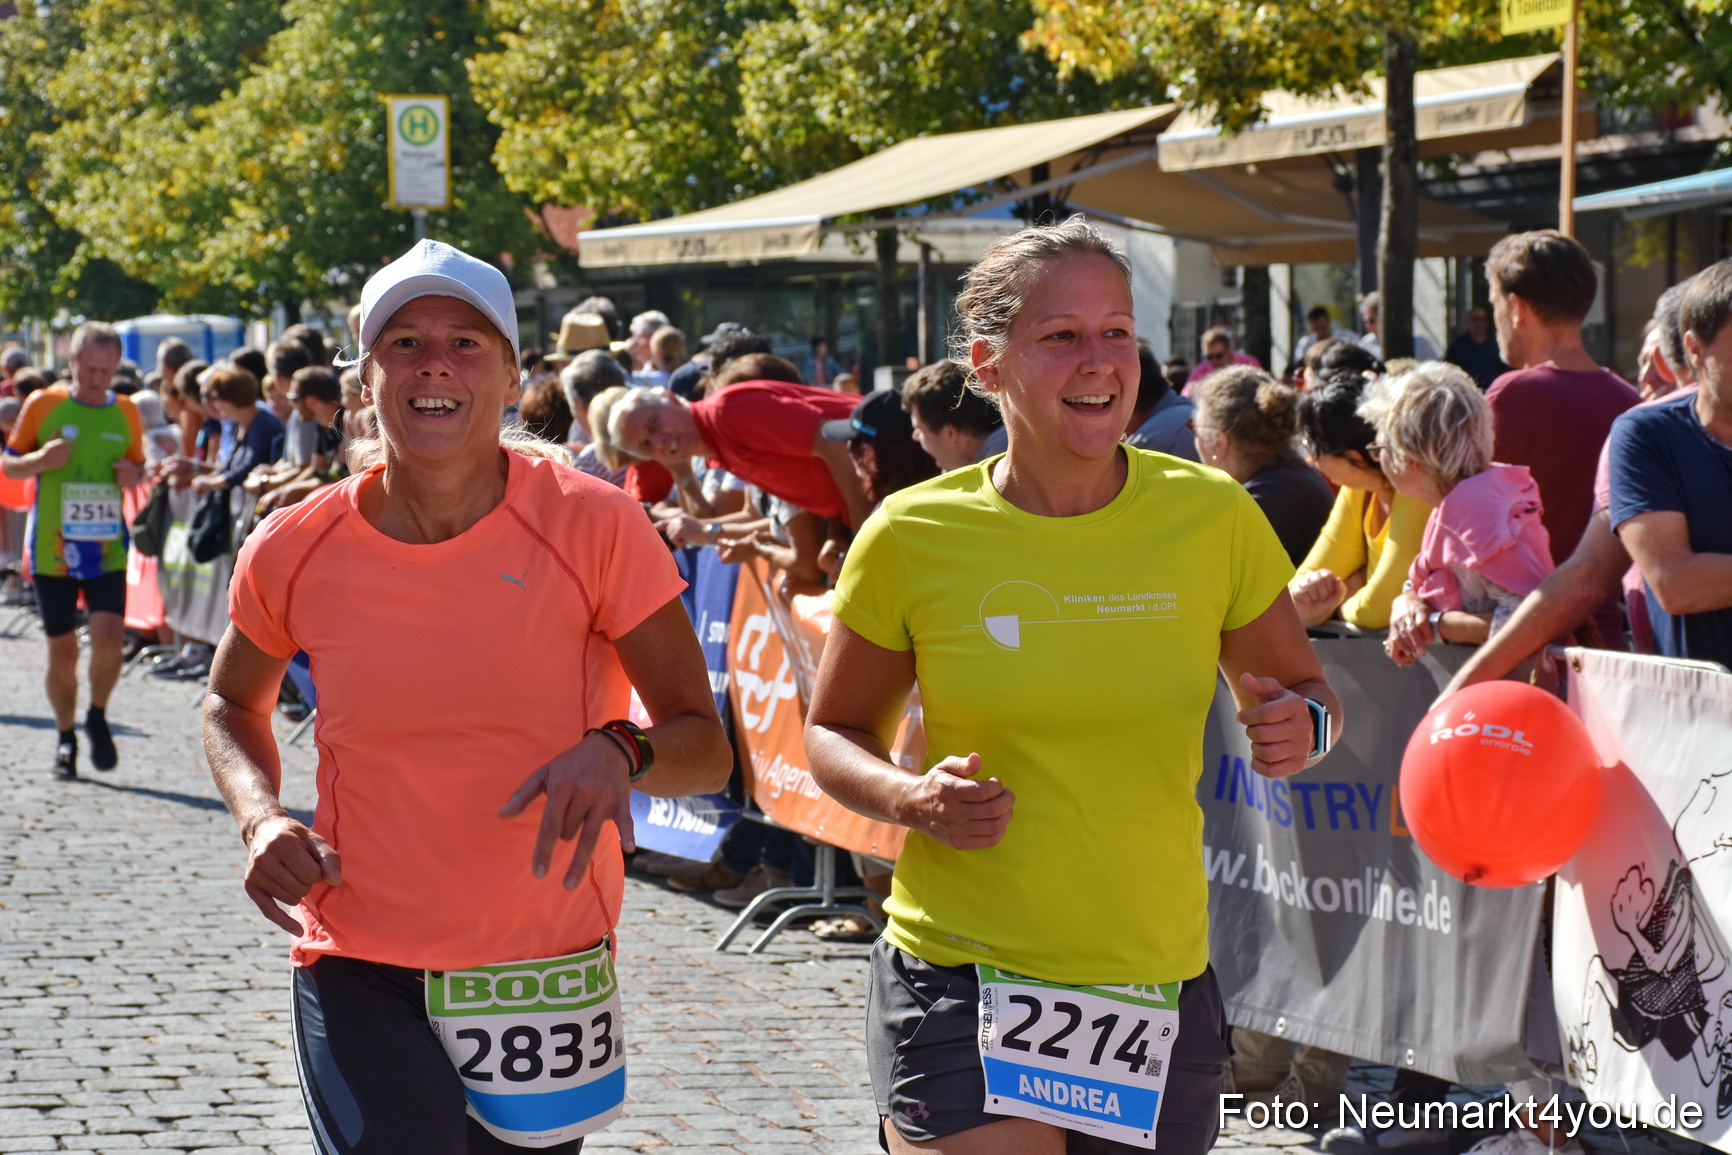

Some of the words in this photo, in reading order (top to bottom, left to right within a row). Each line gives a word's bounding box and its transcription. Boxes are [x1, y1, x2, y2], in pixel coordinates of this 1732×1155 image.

[410, 115, 428, 136] H
[70, 503, 117, 521] 2514
[1063, 594, 1105, 604] Kliniken
[1108, 593, 1125, 602] des
[1127, 591, 1177, 601] Landkreises
[1096, 603, 1145, 613] Neumarkt
[1430, 710, 1534, 748] RÖDL
[1480, 738, 1532, 756] energie
[449, 959, 612, 1004] BOCK
[1001, 994, 1150, 1074] 2214
[1161, 1027, 1171, 1037] D
[456, 1011, 612, 1082] 2833
[1018, 1074, 1121, 1118] ANDREA
